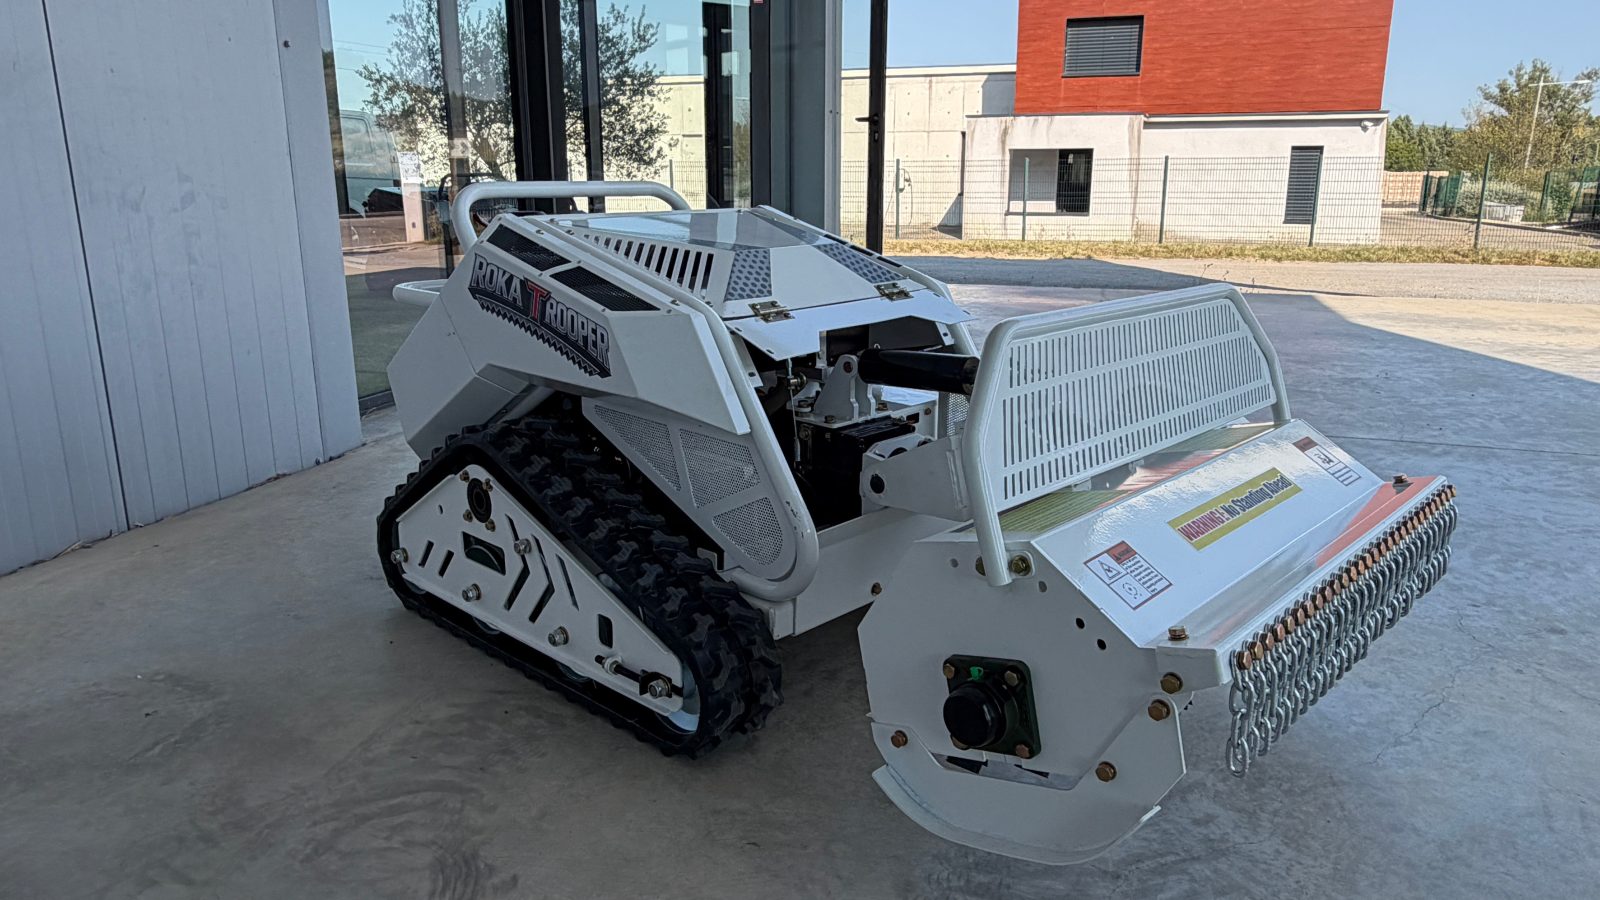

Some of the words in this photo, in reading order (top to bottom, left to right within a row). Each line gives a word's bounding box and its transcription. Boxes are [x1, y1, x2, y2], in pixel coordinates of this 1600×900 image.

[471, 254, 523, 310] ROKA
[524, 277, 610, 370] TROOPER
[1221, 504, 1241, 518] No
[1231, 487, 1274, 515] Standing
[1263, 474, 1294, 496] Ahead
